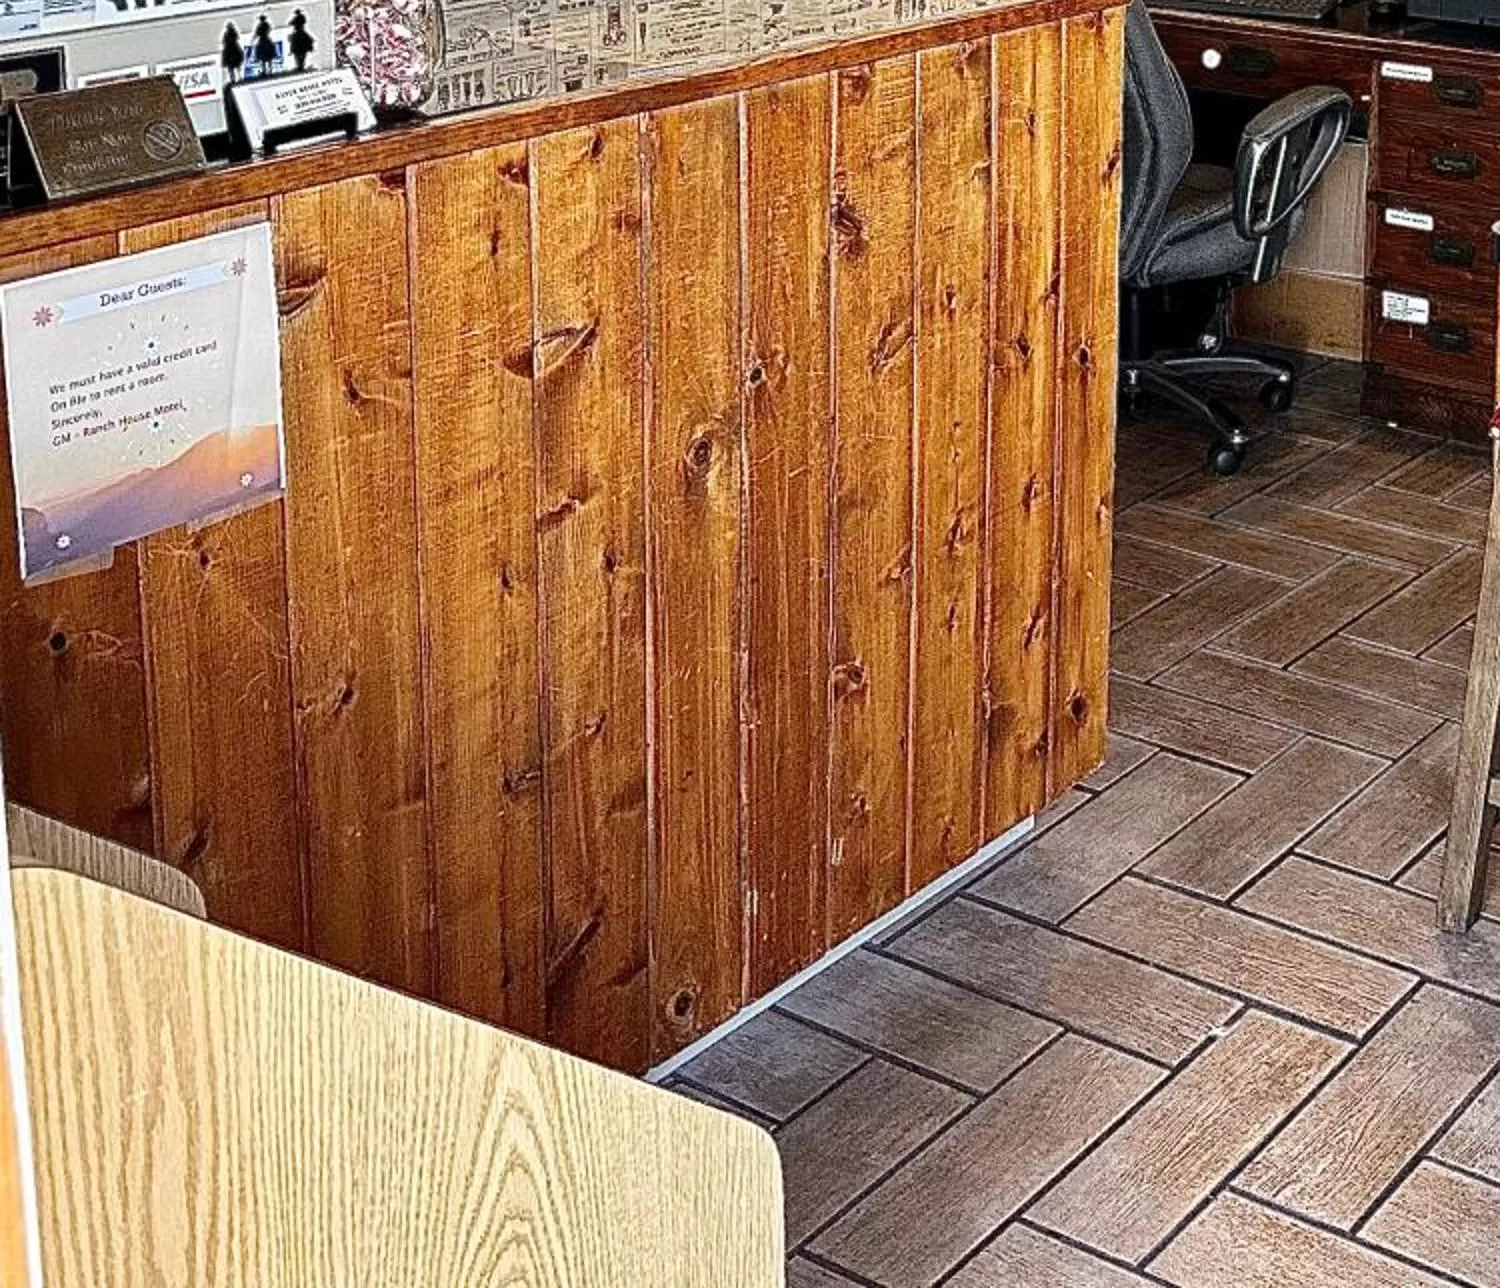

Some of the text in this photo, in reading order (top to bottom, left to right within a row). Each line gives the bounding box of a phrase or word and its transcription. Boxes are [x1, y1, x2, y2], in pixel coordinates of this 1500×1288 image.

[99, 286, 135, 308] Dear
[68, 374, 97, 392] must
[99, 367, 124, 382] have
[135, 354, 162, 373] valid
[162, 346, 194, 364] credit
[50, 399, 68, 414] On
[51, 431, 72, 449] GM
[82, 420, 117, 439] Ranch
[118, 410, 152, 428] House
